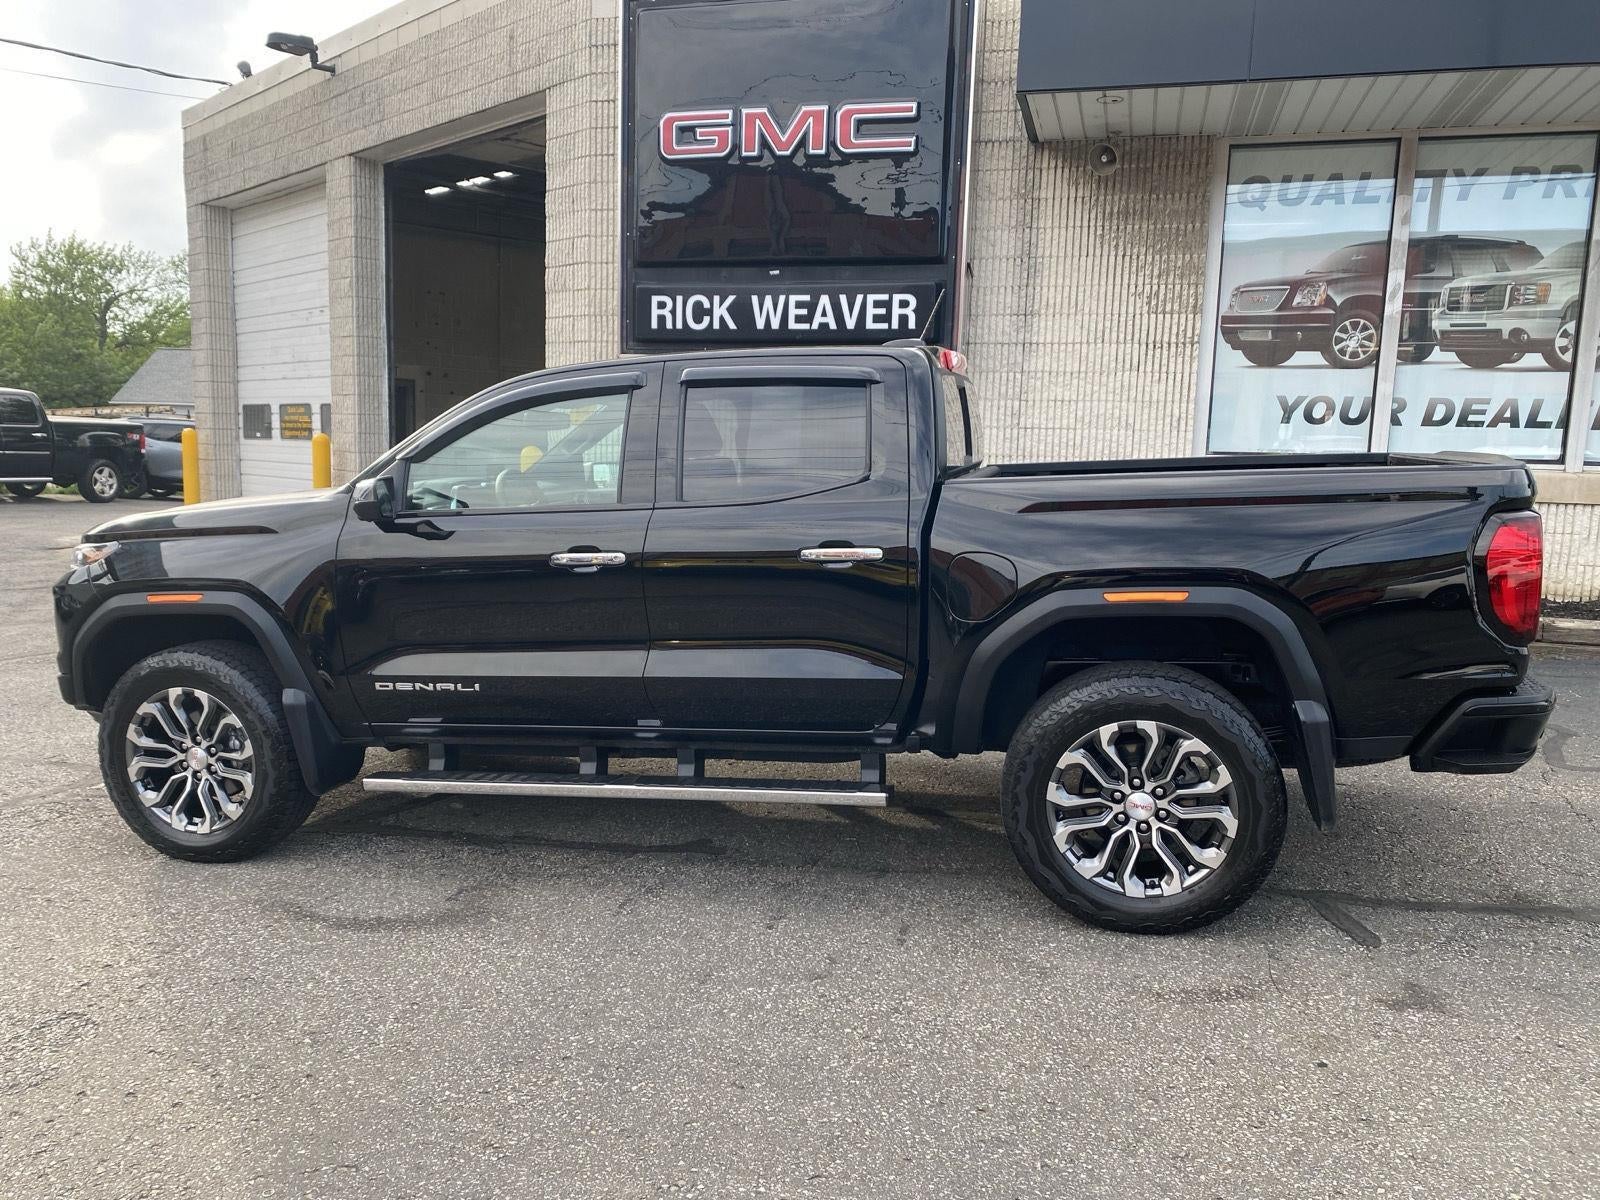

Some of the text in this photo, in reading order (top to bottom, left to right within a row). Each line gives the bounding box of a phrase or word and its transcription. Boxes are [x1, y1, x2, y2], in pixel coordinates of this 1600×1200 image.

[659, 101, 918, 160] GMC
[1237, 168, 1490, 212] QUALTY
[650, 293, 917, 330] RICK WEAVER
[1276, 395, 1600, 431] YOUR DEAL
[375, 682, 480, 691] DENALI
